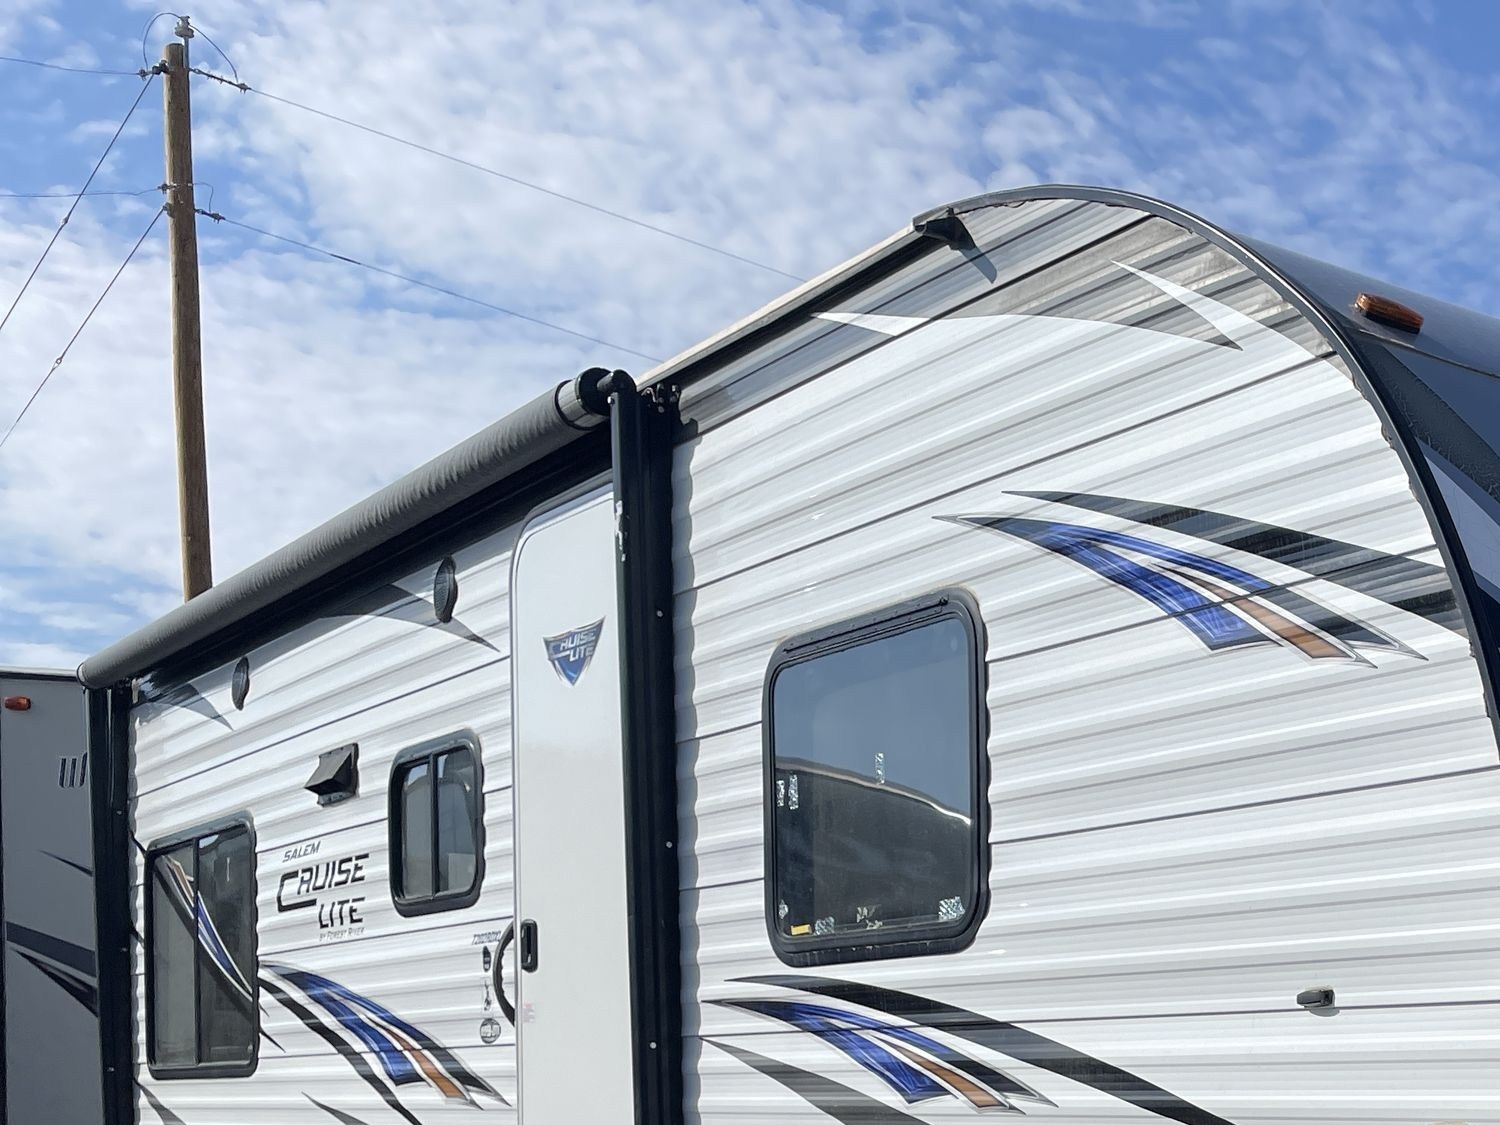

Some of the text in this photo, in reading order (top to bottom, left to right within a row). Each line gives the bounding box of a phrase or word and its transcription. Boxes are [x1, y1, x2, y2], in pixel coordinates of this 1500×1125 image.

[548, 628, 597, 660] CRUISE
[282, 841, 321, 863] SALEM
[276, 853, 370, 913] CRUISE
[318, 896, 365, 929] LITE
